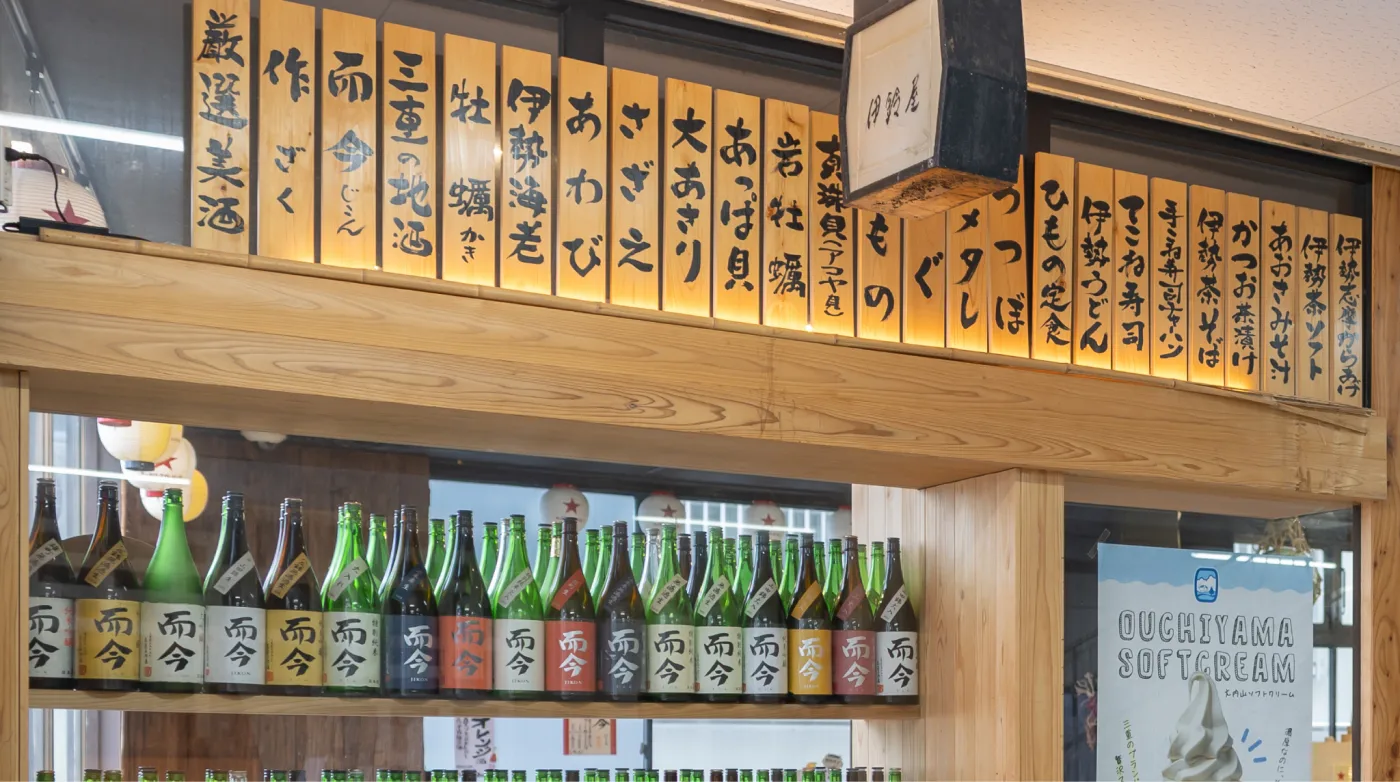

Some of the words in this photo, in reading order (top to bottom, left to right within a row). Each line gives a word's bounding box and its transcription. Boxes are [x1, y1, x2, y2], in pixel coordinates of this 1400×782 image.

[197, 9, 248, 235] 厳選美酒
[324, 51, 374, 173] 而今
[388, 50, 433, 257] 三重の地酒
[448, 79, 494, 222] 牡蠣
[507, 79, 551, 264] 伊勢海老
[562, 91, 603, 277] あわび
[618, 103, 654, 273] さざえ
[671, 107, 708, 283] 大あさり
[720, 117, 757, 291] あっぱ貝
[769, 131, 806, 298] 岩牡蠣
[460, 227, 485, 264] かき
[864, 213, 895, 322] もの
[914, 251, 944, 299] ぐ
[1040, 179, 1073, 346] ひもの定食
[1080, 196, 1112, 354] 伊勢うどん
[1118, 195, 1145, 351] てこね寿司
[1197, 207, 1224, 368] 伊勢茶そば
[1231, 220, 1258, 375] かつお茶漬け
[1269, 221, 1294, 384] あおさみそ汁
[1302, 233, 1329, 381] 伊勢茶ソフト
[29, 605, 60, 669] 而今
[94, 607, 133, 670] 而今
[157, 610, 196, 672] 而今
[224, 616, 257, 667] 而今
[280, 617, 316, 676] 而今
[331, 619, 367, 677] 而今
[403, 625, 433, 674] 而今
[451, 620, 484, 676] 而今
[505, 628, 536, 675] 而今
[558, 630, 588, 677] 而今
[608, 628, 640, 684] 而今
[654, 630, 685, 684] 而今
[703, 632, 734, 686] 而今
[798, 637, 824, 681] 而今
[1118, 609, 1294, 647] OUCHIYAMA
[749, 634, 779, 686] 而今
[842, 636, 870, 687] 而今
[887, 637, 914, 688] 而今
[1118, 647, 1296, 683] SOFTCREAM
[1123, 719, 1139, 782] 三重のブラン
